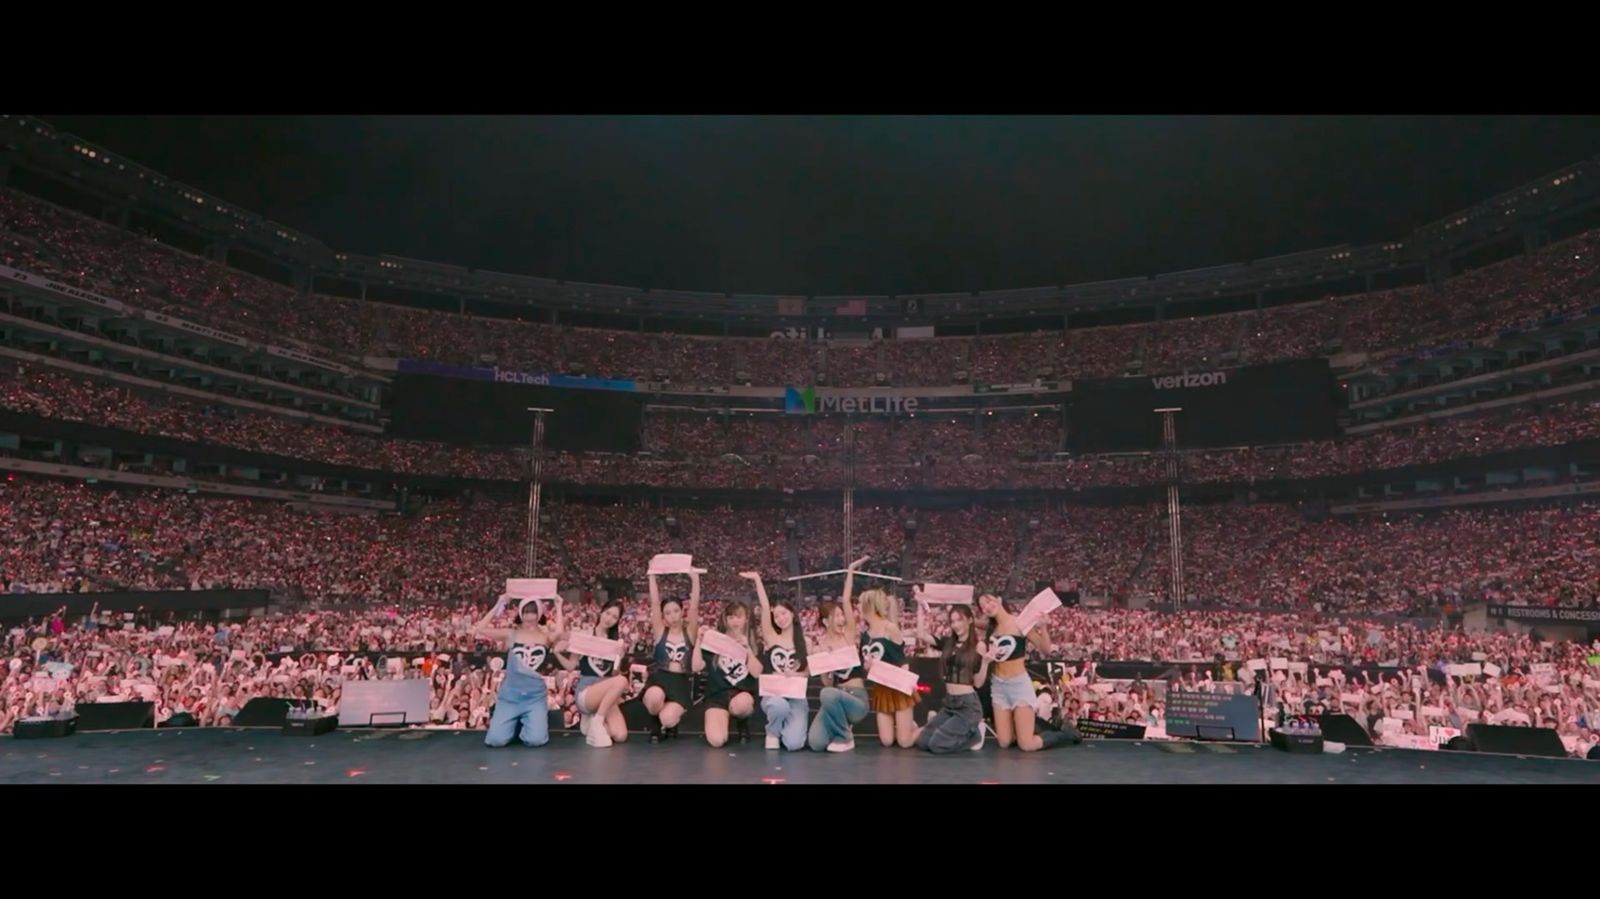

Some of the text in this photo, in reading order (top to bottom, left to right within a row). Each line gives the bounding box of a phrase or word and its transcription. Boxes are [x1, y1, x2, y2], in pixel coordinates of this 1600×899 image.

[494, 370, 550, 385] HCLTech
[1151, 370, 1227, 390] verizon
[819, 395, 919, 413] MetLife
[1507, 607, 1551, 619] RESTROOMS
